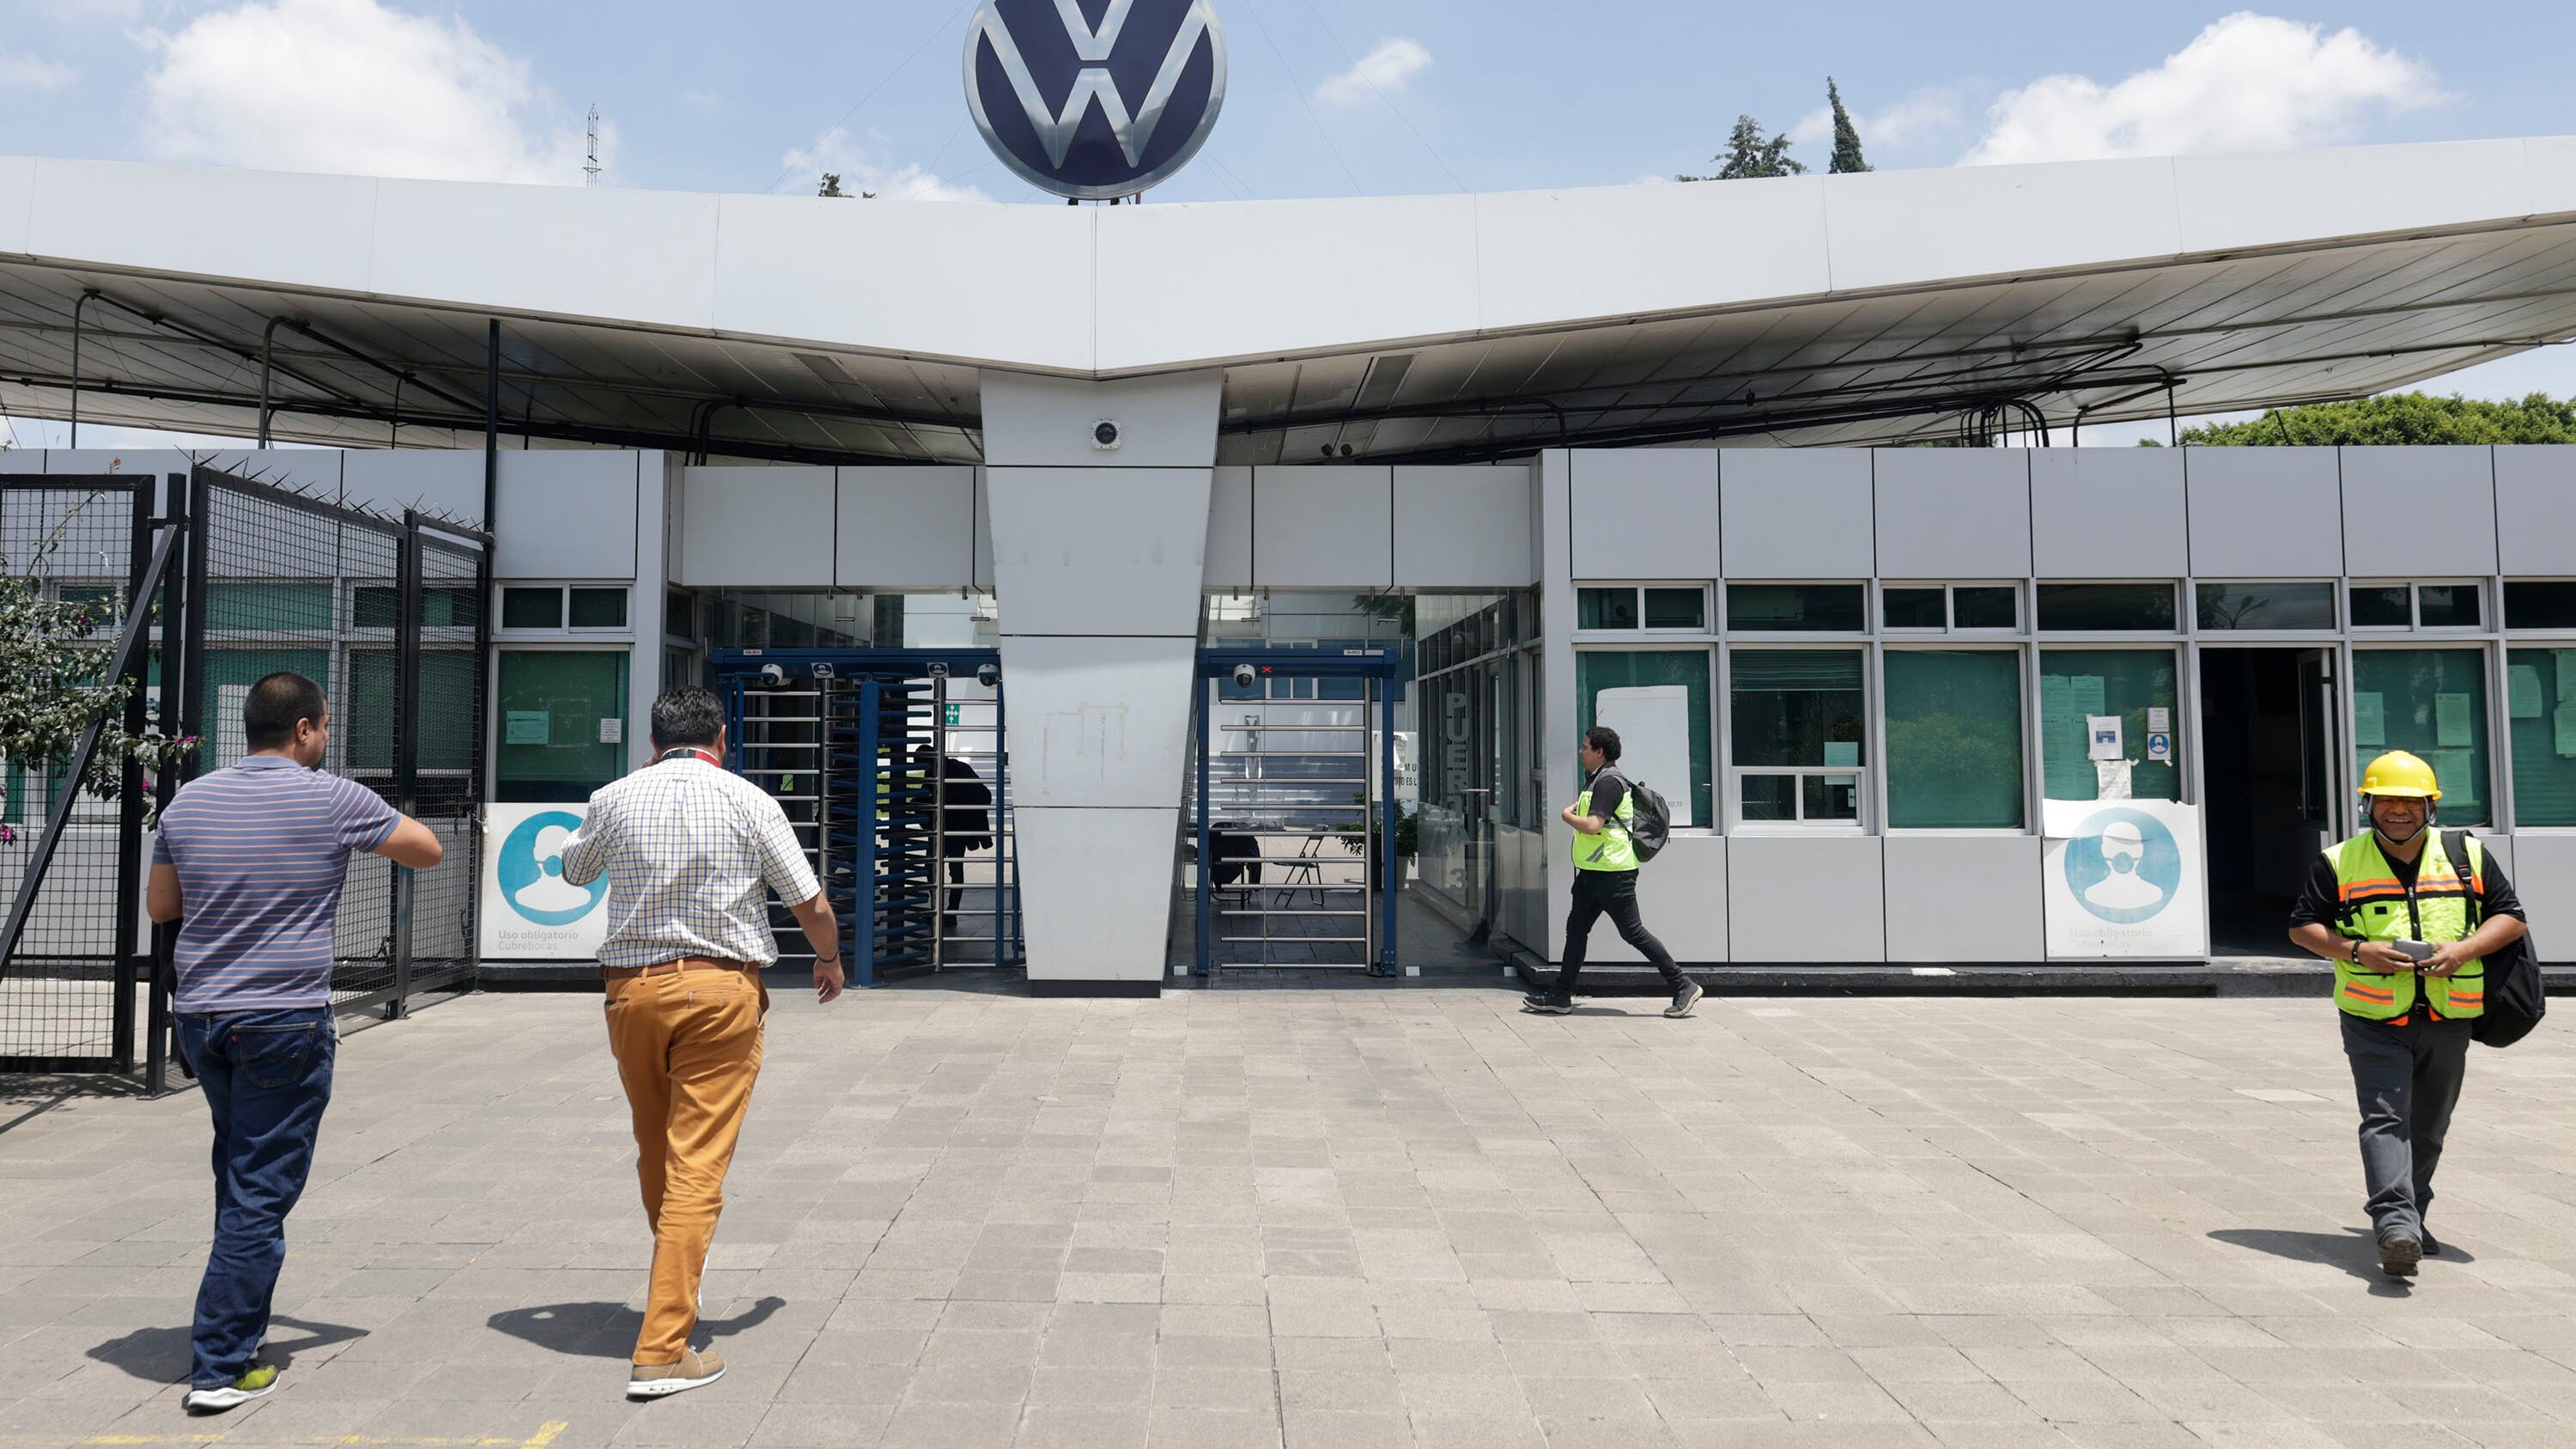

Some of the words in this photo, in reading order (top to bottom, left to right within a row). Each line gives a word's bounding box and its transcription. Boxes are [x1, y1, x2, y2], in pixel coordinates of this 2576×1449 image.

[498, 930, 518, 940] Uso
[521, 930, 578, 941] obligatorio
[498, 941, 557, 950] Cubrebocas
